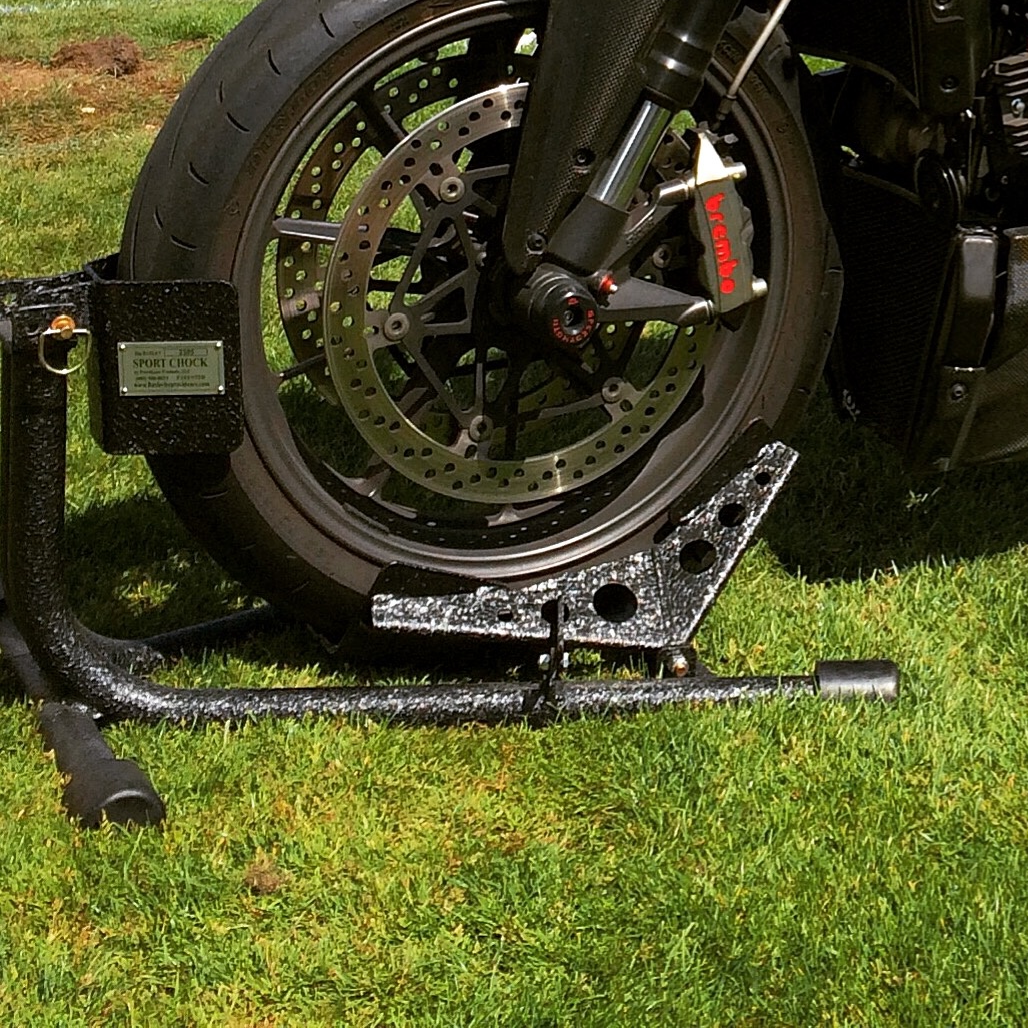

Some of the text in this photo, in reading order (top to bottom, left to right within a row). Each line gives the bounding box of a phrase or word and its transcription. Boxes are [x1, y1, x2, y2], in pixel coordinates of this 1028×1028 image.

[705, 192, 739, 295] brembo
[132, 357, 208, 369] SPORT CHOCK
